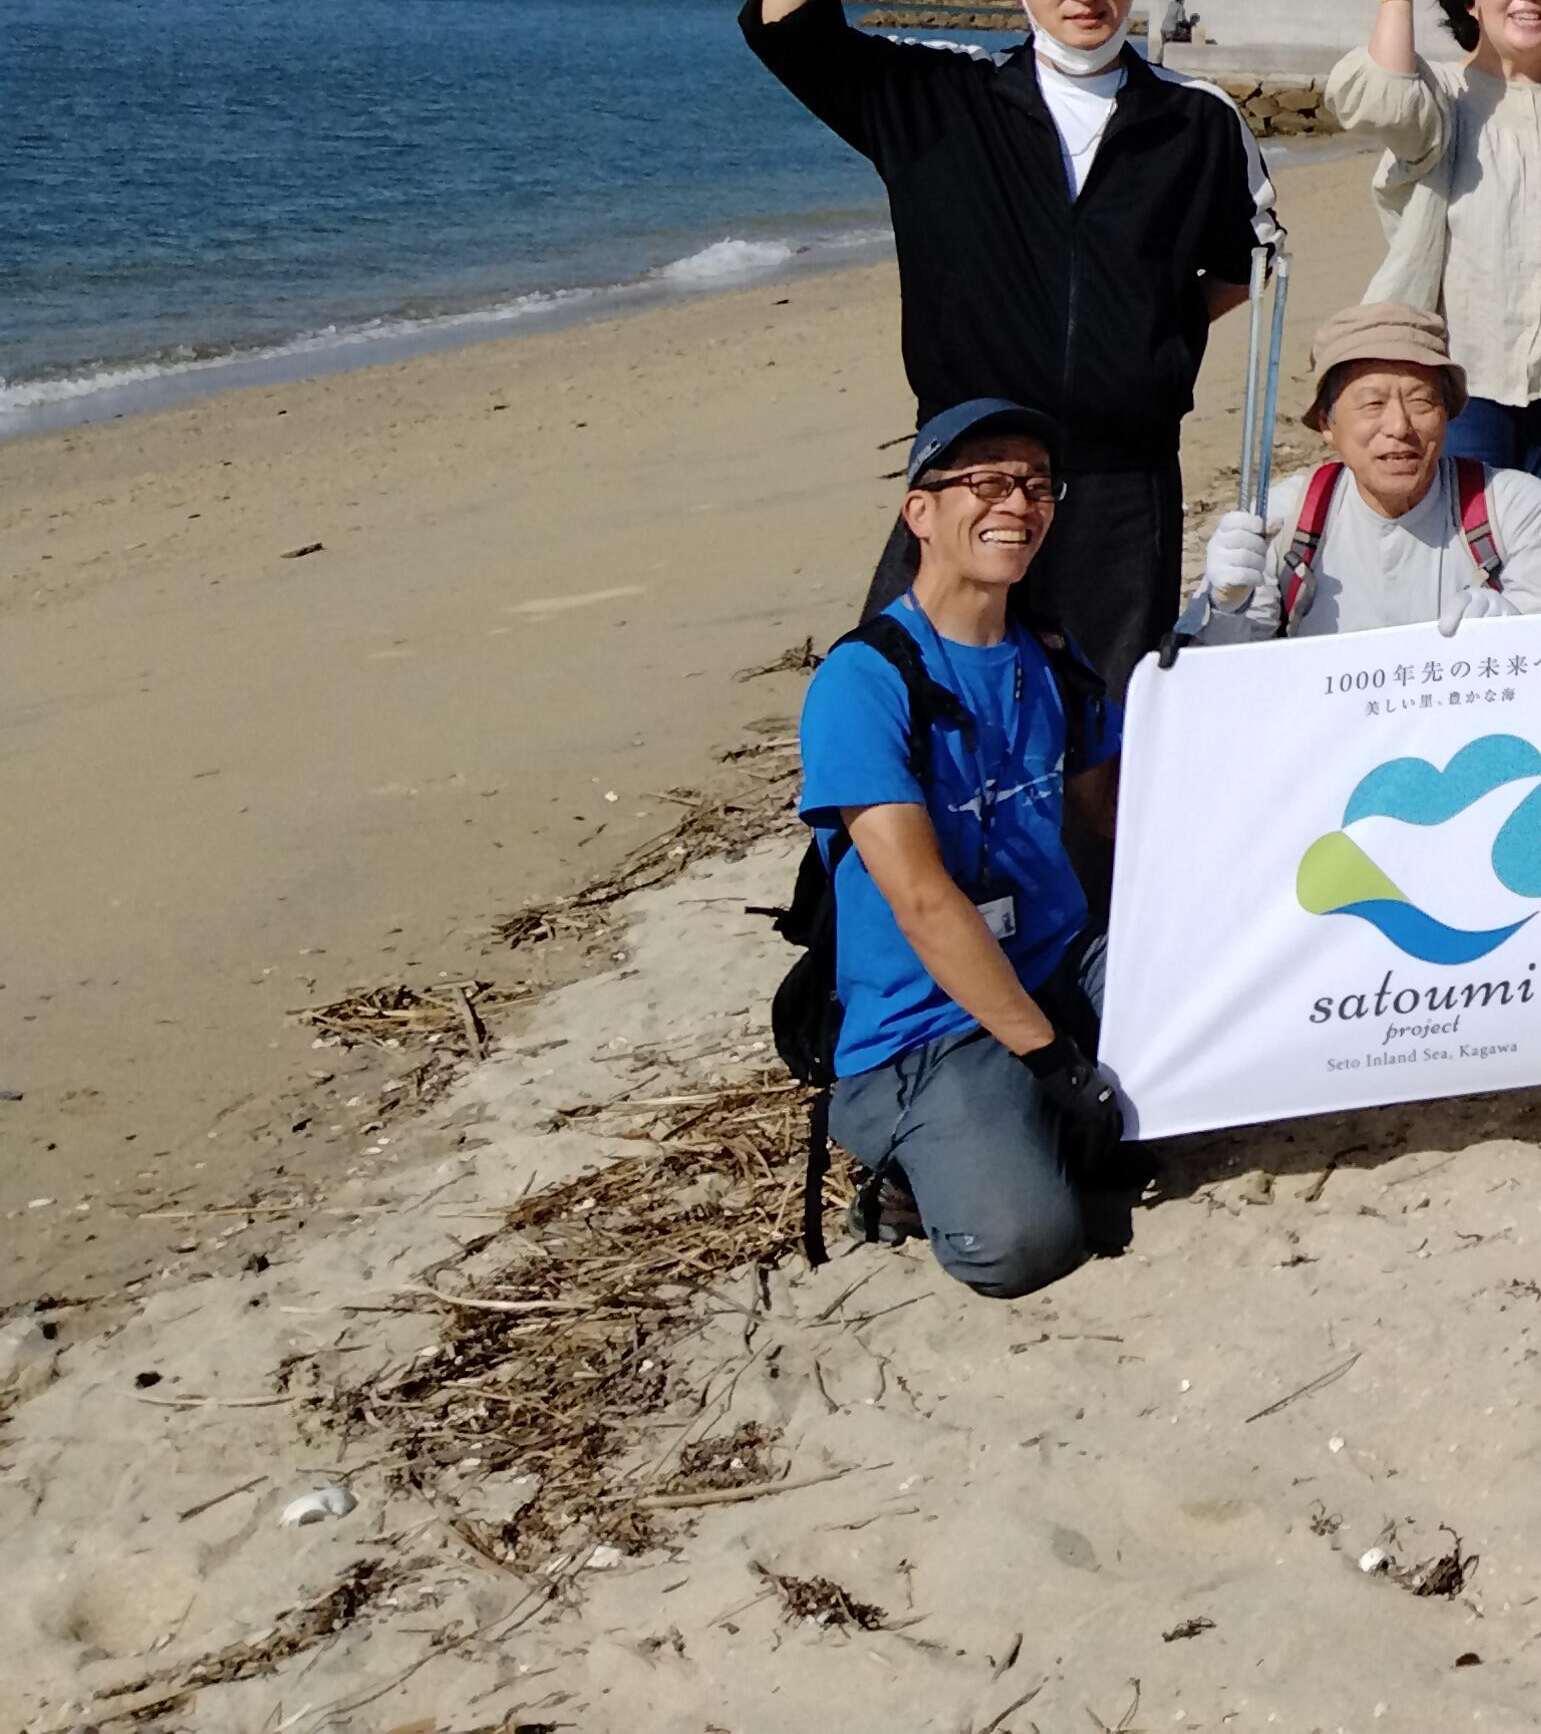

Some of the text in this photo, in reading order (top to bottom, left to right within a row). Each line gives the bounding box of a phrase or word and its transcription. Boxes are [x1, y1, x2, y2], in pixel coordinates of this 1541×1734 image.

[1367, 687, 1516, 716] 美しい里、豊かな海
[1309, 963, 1537, 1024] satoumi
[1381, 1015, 1461, 1046] project
[1326, 1058, 1361, 1072] Seto
[1366, 1050, 1417, 1068] Inland
[1459, 1042, 1518, 1061] Kagawa
